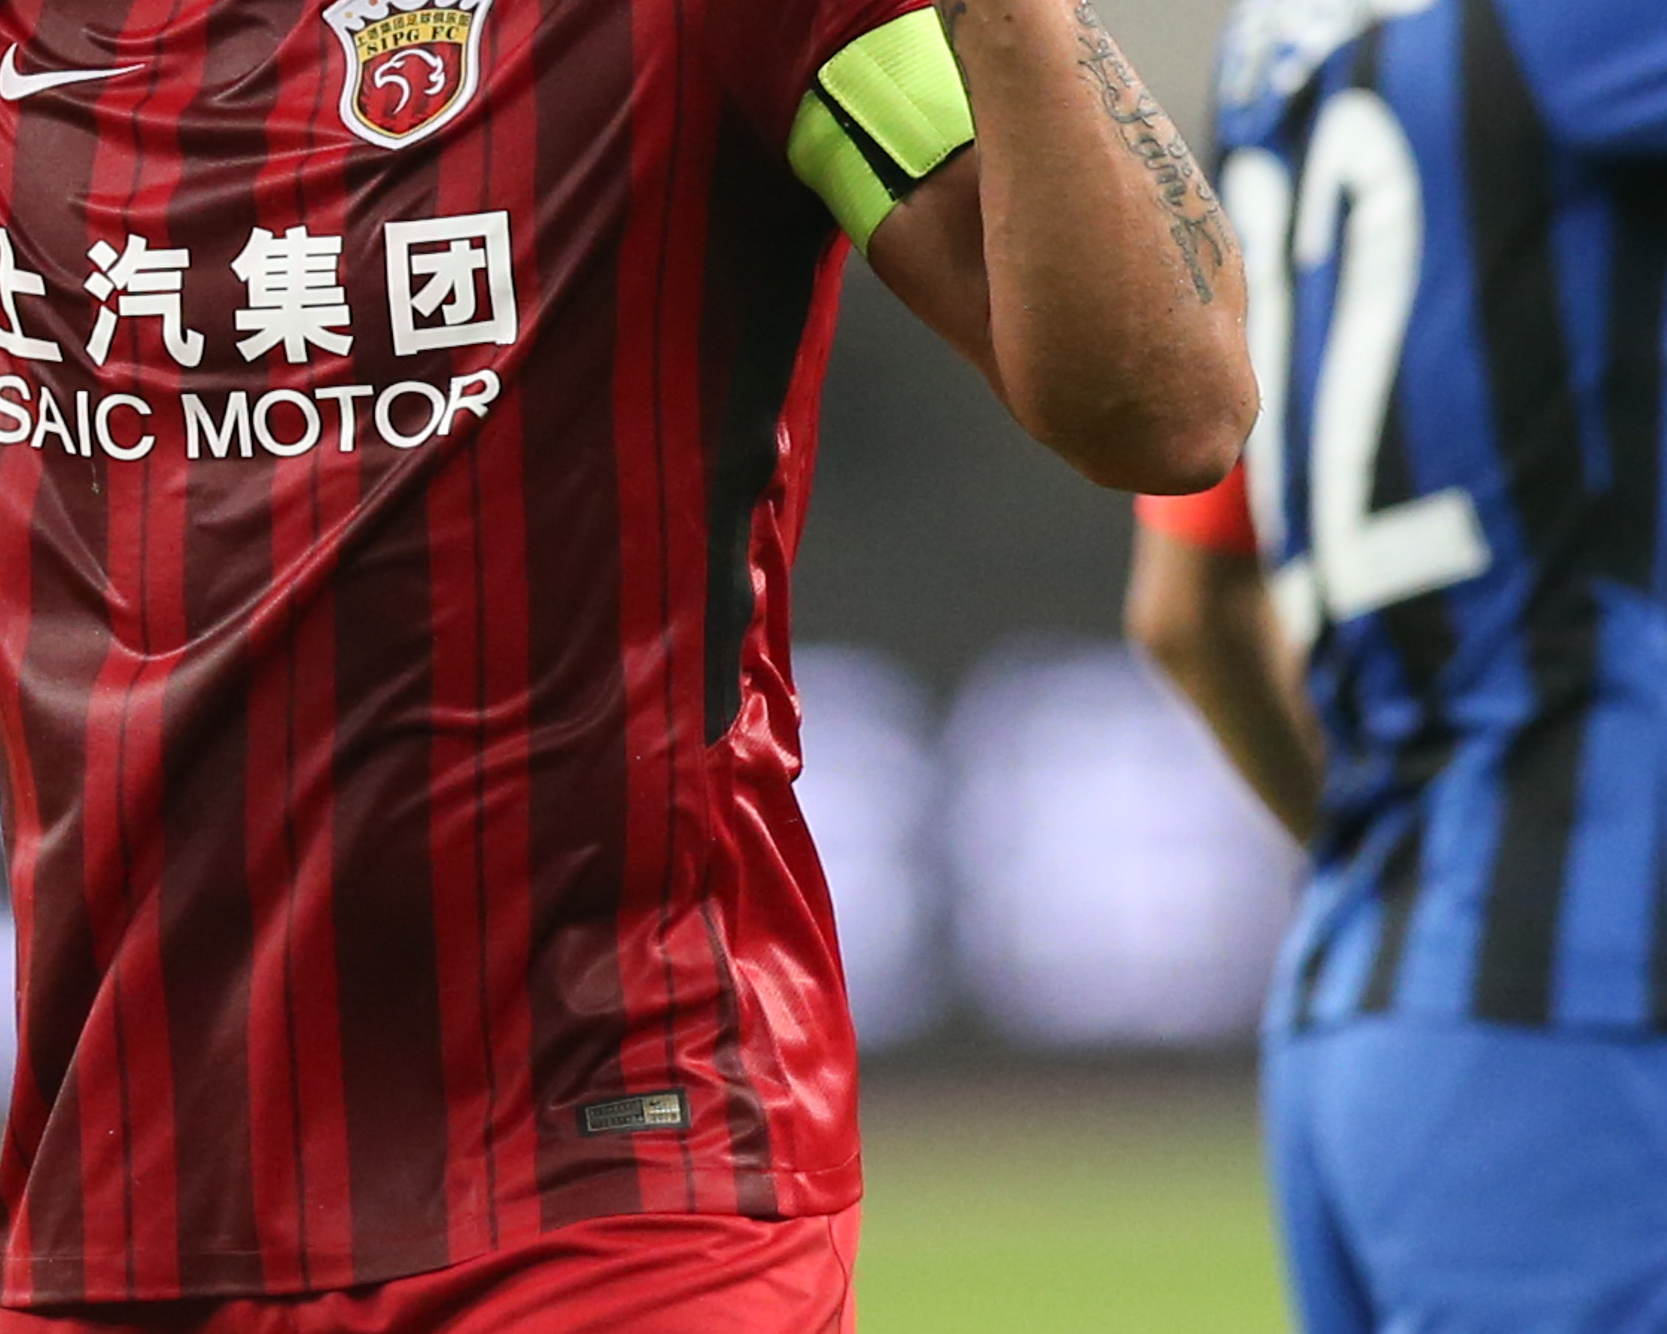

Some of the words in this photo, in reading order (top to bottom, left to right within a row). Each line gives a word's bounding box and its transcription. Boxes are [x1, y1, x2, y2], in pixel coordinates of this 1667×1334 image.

[367, 28, 420, 56] SIPG
[432, 25, 460, 41] FC
[181, 369, 501, 460] MOTOR
